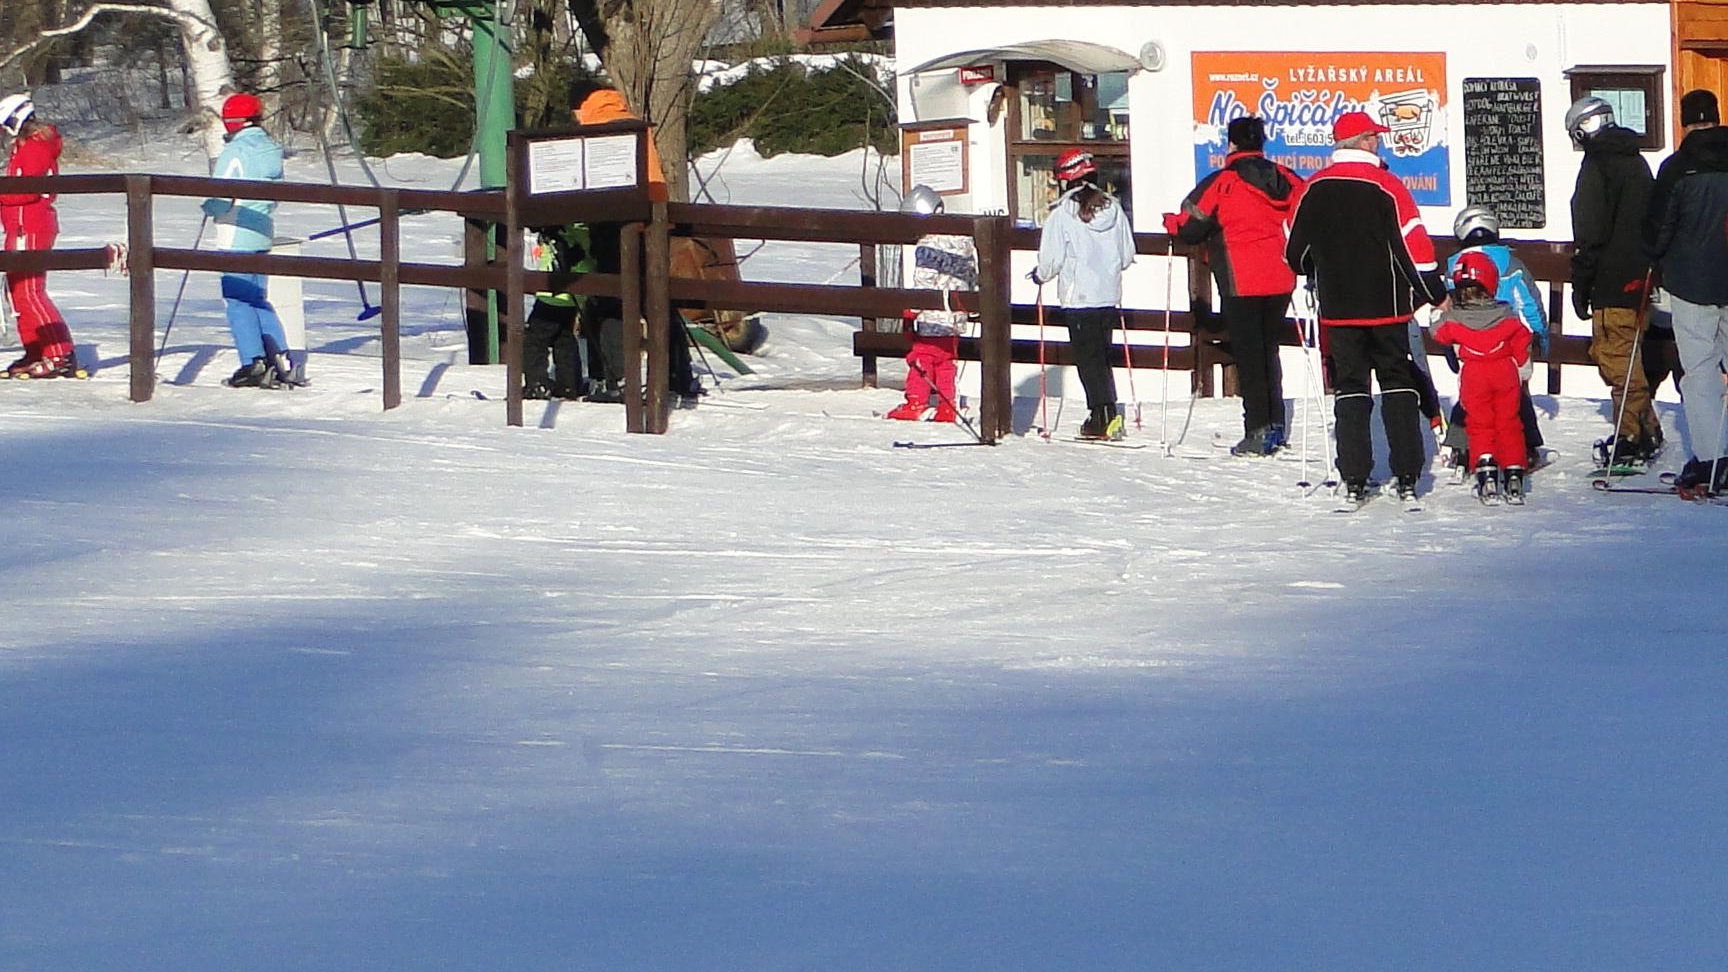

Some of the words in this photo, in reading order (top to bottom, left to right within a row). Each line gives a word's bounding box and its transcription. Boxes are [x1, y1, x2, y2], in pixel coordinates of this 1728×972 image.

[1289, 65, 1368, 83] LYŽAŘSKÝ
[1374, 65, 1425, 83] AREÁL
[1209, 91, 1246, 126] Na
[1306, 133, 1324, 144] 603
[1299, 155, 1323, 170] PRO
[1402, 172, 1438, 191] OVÁNÍ
